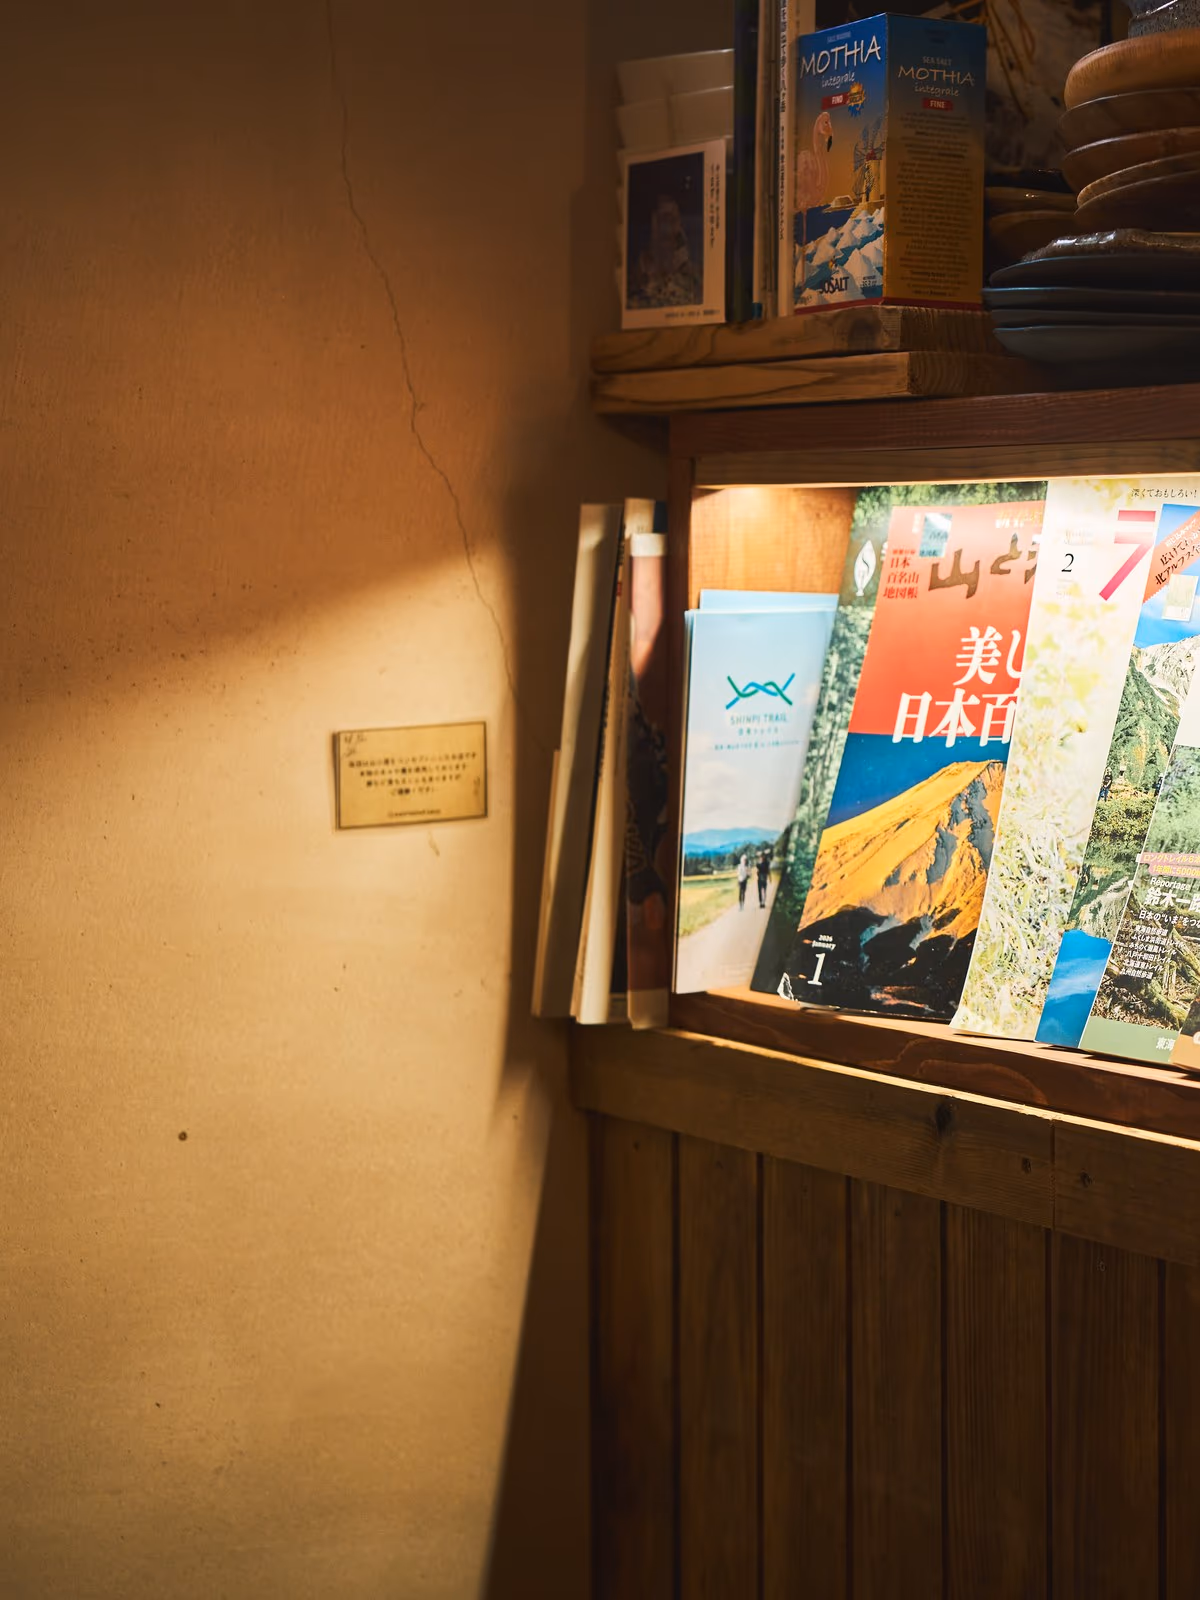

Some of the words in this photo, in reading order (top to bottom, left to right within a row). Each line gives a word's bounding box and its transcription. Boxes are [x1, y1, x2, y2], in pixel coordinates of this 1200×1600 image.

[800, 35, 882, 79] MOTHIA
[821, 70, 856, 89] integrale
[898, 65, 975, 87] MOTHIA
[914, 82, 960, 97] integrale
[929, 100, 946, 109] FINE
[1061, 553, 1075, 573] 2
[892, 687, 1020, 748] 日本百
[1150, 877, 1192, 891] Reportage
[807, 952, 826, 986] 1
